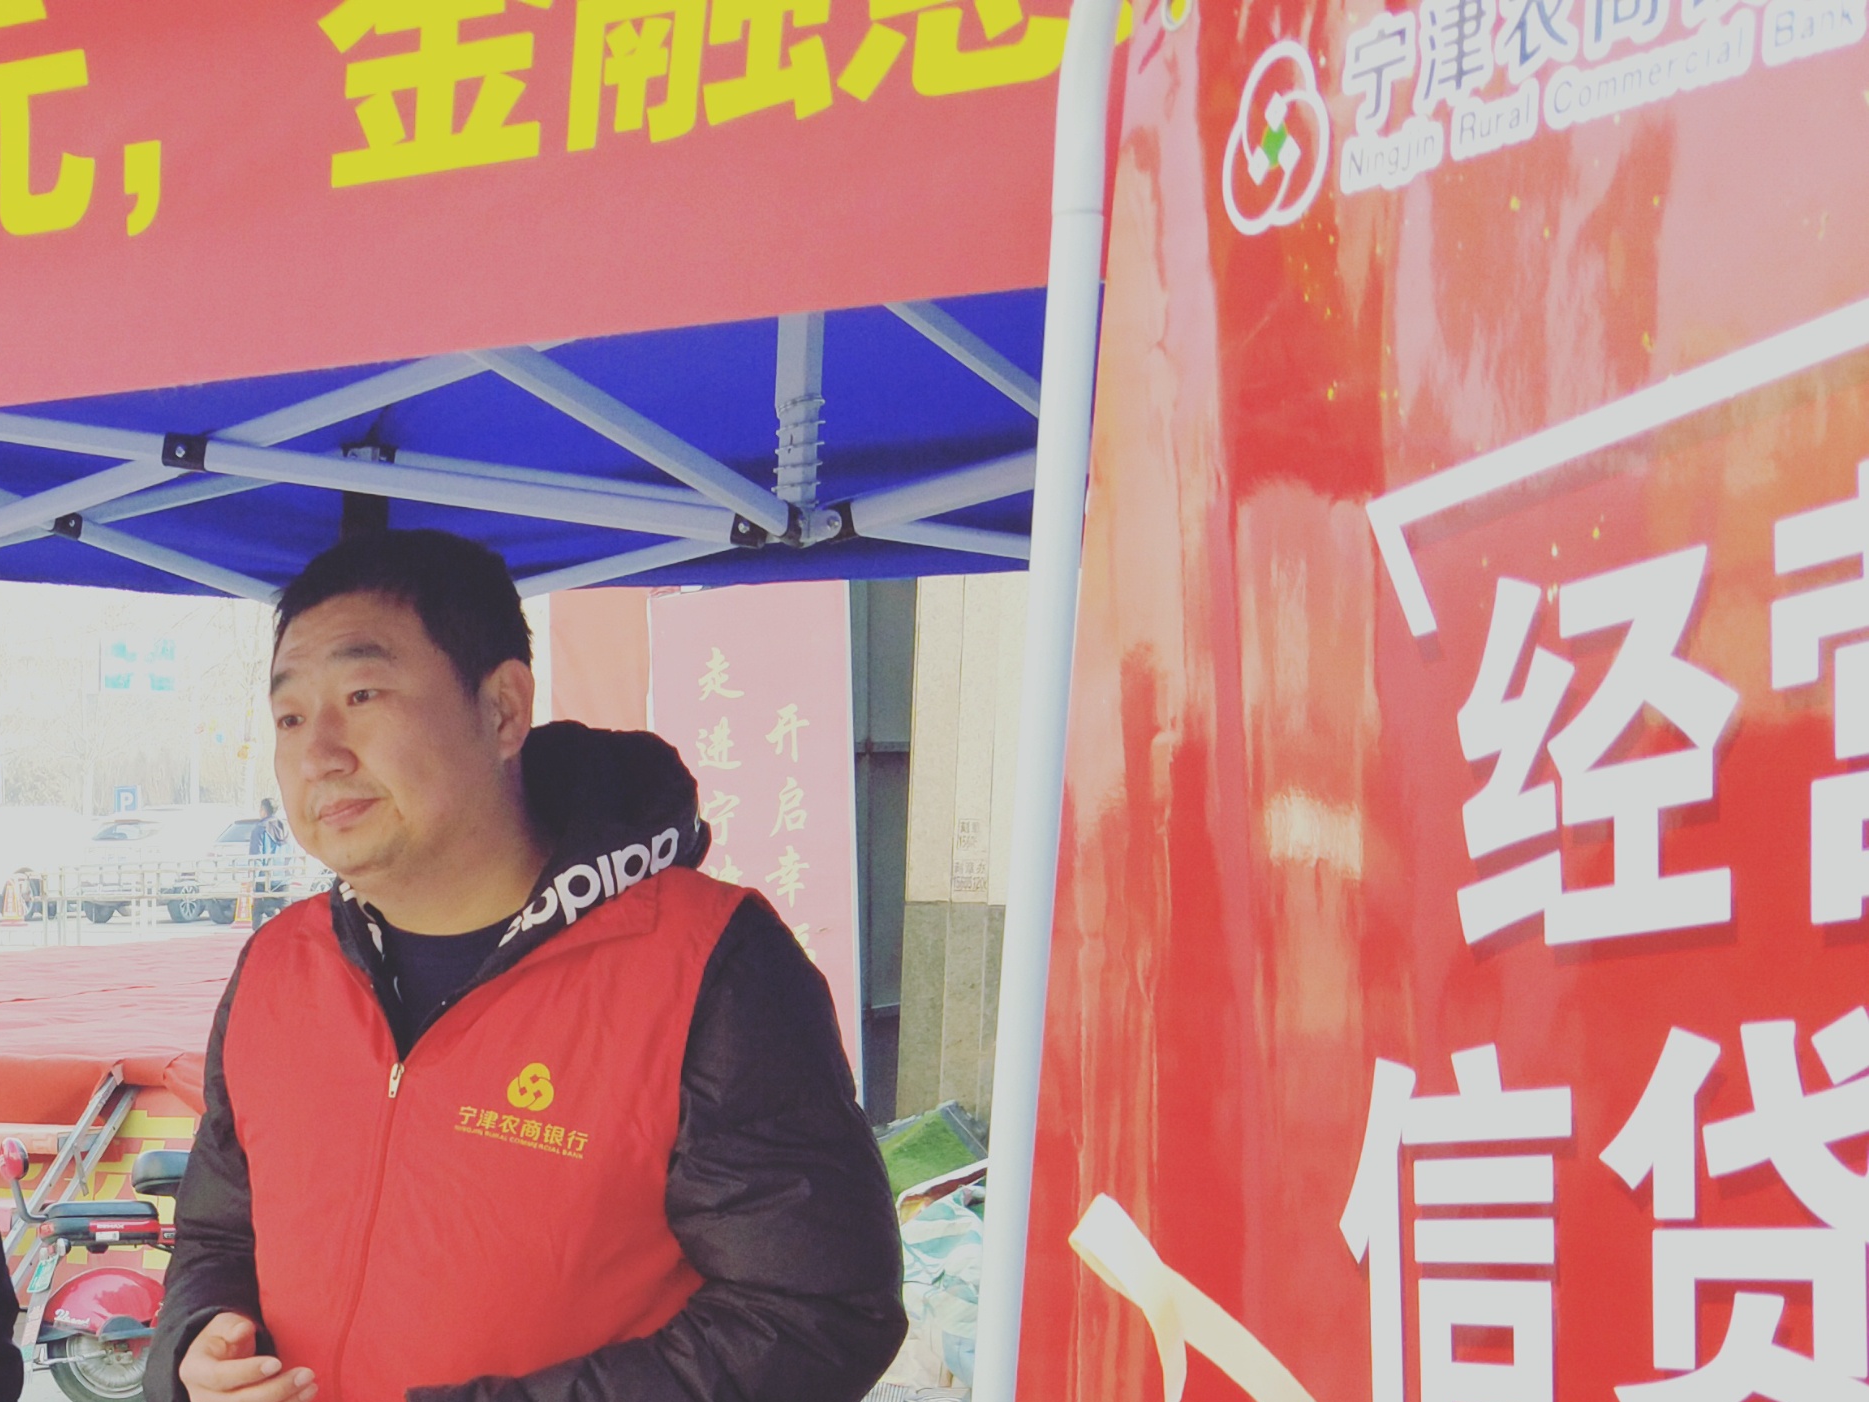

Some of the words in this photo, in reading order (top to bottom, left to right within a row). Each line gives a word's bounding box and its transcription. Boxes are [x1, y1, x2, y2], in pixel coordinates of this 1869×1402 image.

[1349, 0, 1718, 121] 宁津农
[1458, 103, 1532, 146] Rural
[1552, 27, 1746, 116] Commercial
[1772, 8, 1856, 49] Bank
[459, 1105, 589, 1152] 宁津农商银行
